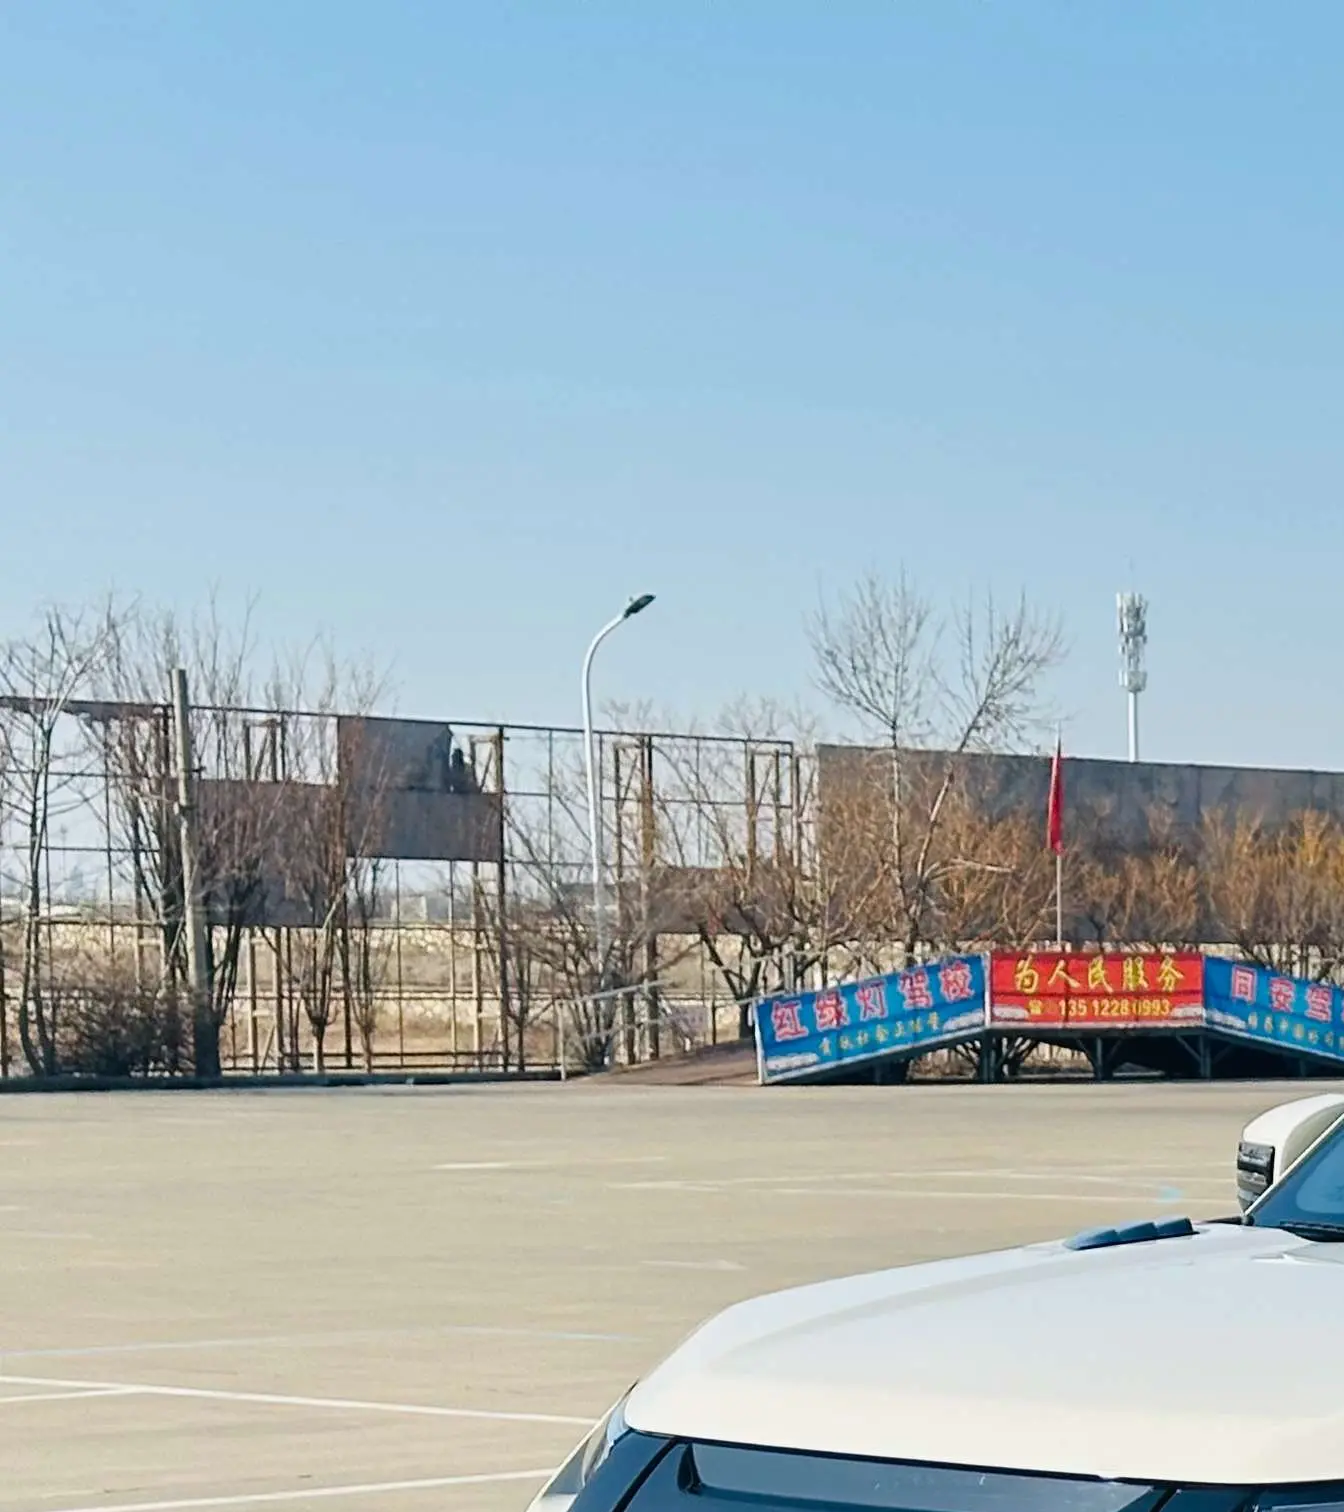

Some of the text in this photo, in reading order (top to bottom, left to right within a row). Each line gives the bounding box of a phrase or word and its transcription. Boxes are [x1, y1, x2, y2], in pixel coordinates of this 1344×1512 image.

[771, 961, 974, 1042] 红绿灯驾校
[1014, 954, 1185, 994] 为人民服务
